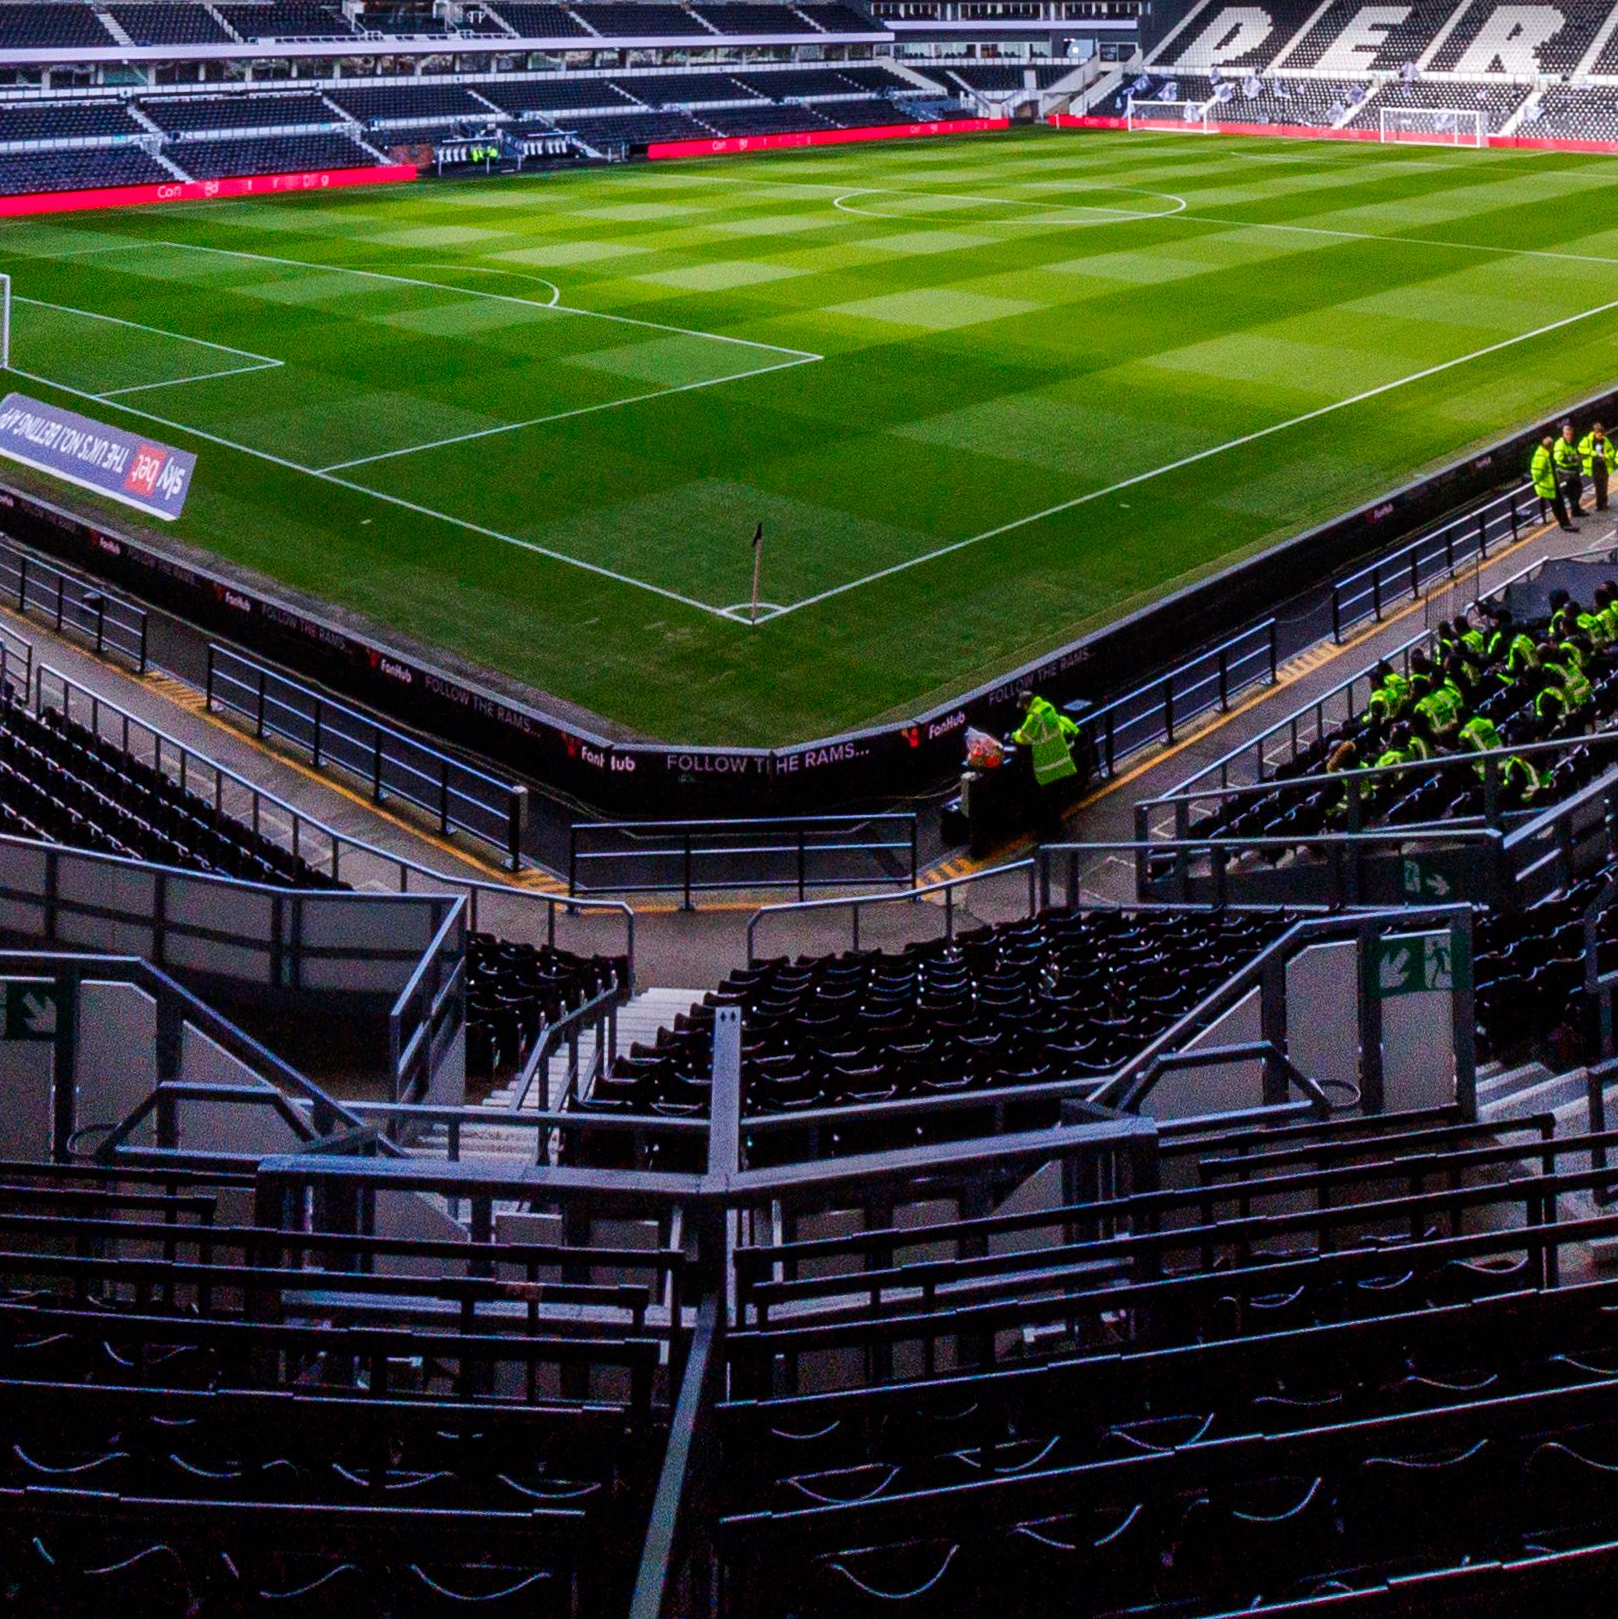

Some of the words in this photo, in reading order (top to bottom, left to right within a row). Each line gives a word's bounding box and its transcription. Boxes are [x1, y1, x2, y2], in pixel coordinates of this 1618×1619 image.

[11, 413, 64, 446] BETTING
[77, 435, 110, 465] UK'S
[102, 443, 130, 473] THE
[131, 453, 161, 490] bet
[157, 456, 186, 501] sky
[425, 676, 470, 707] FOLLOW
[473, 690, 496, 717] THE
[666, 754, 748, 774] FOLLOW
[753, 755, 800, 775] THE
